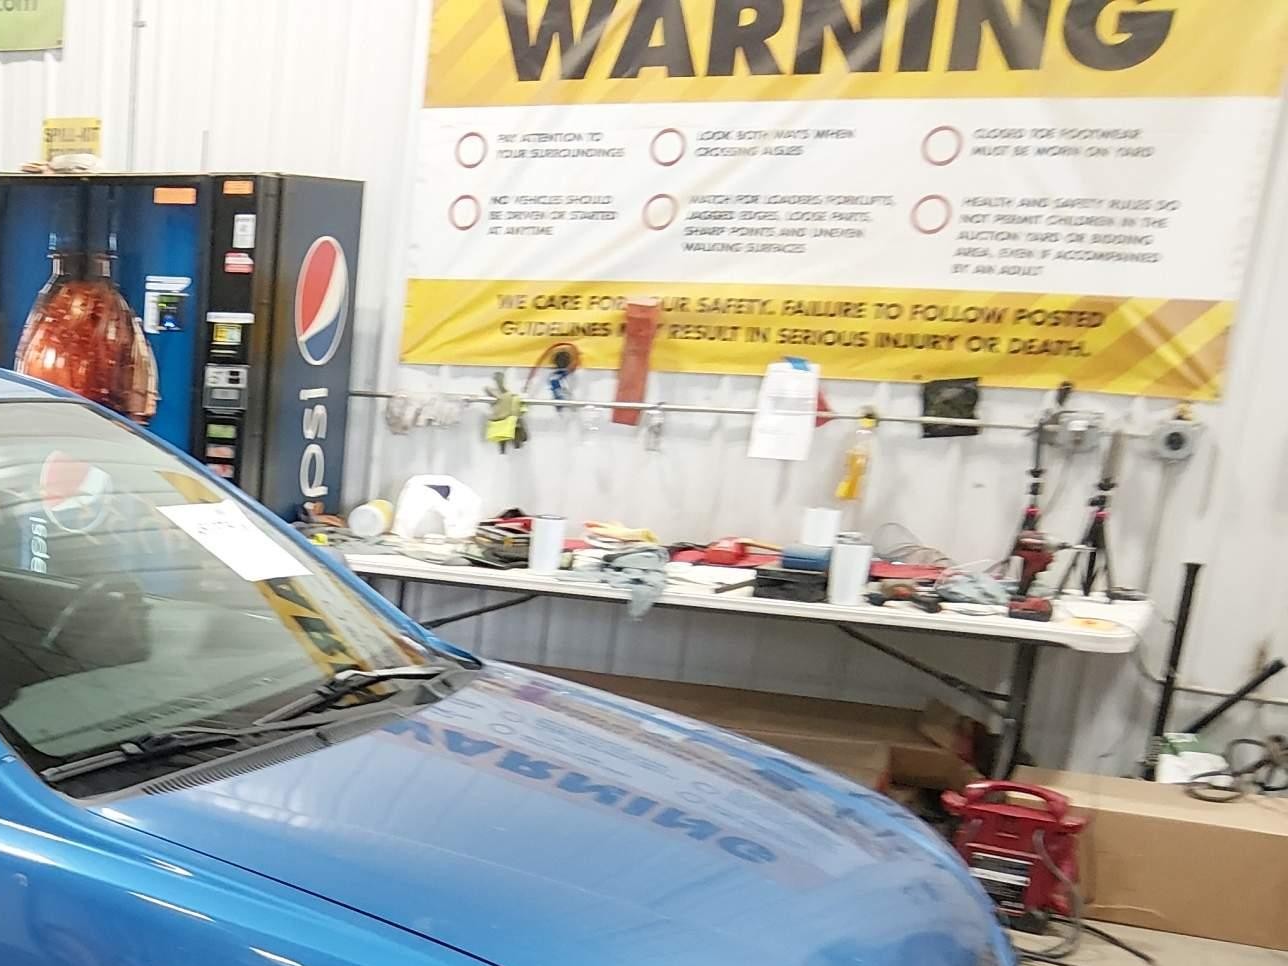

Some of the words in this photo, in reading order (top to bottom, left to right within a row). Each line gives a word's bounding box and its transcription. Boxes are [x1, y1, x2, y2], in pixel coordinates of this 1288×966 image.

[500, 0, 1179, 81] WARNING
[497, 295, 527, 310] WE
[531, 295, 581, 310] CARE
[587, 295, 626, 310] FOR
[782, 299, 866, 319] FAILURE
[873, 302, 903, 320] TO
[911, 303, 1009, 324] FOLLOW
[1014, 307, 1106, 328] POSTED
[499, 320, 609, 337] GUIDELINES
[667, 323, 741, 342] RESULT
[744, 325, 768, 343] IN
[776, 326, 869, 347] SERIOUS
[874, 331, 960, 350] INJURY
[964, 335, 1000, 354] OR
